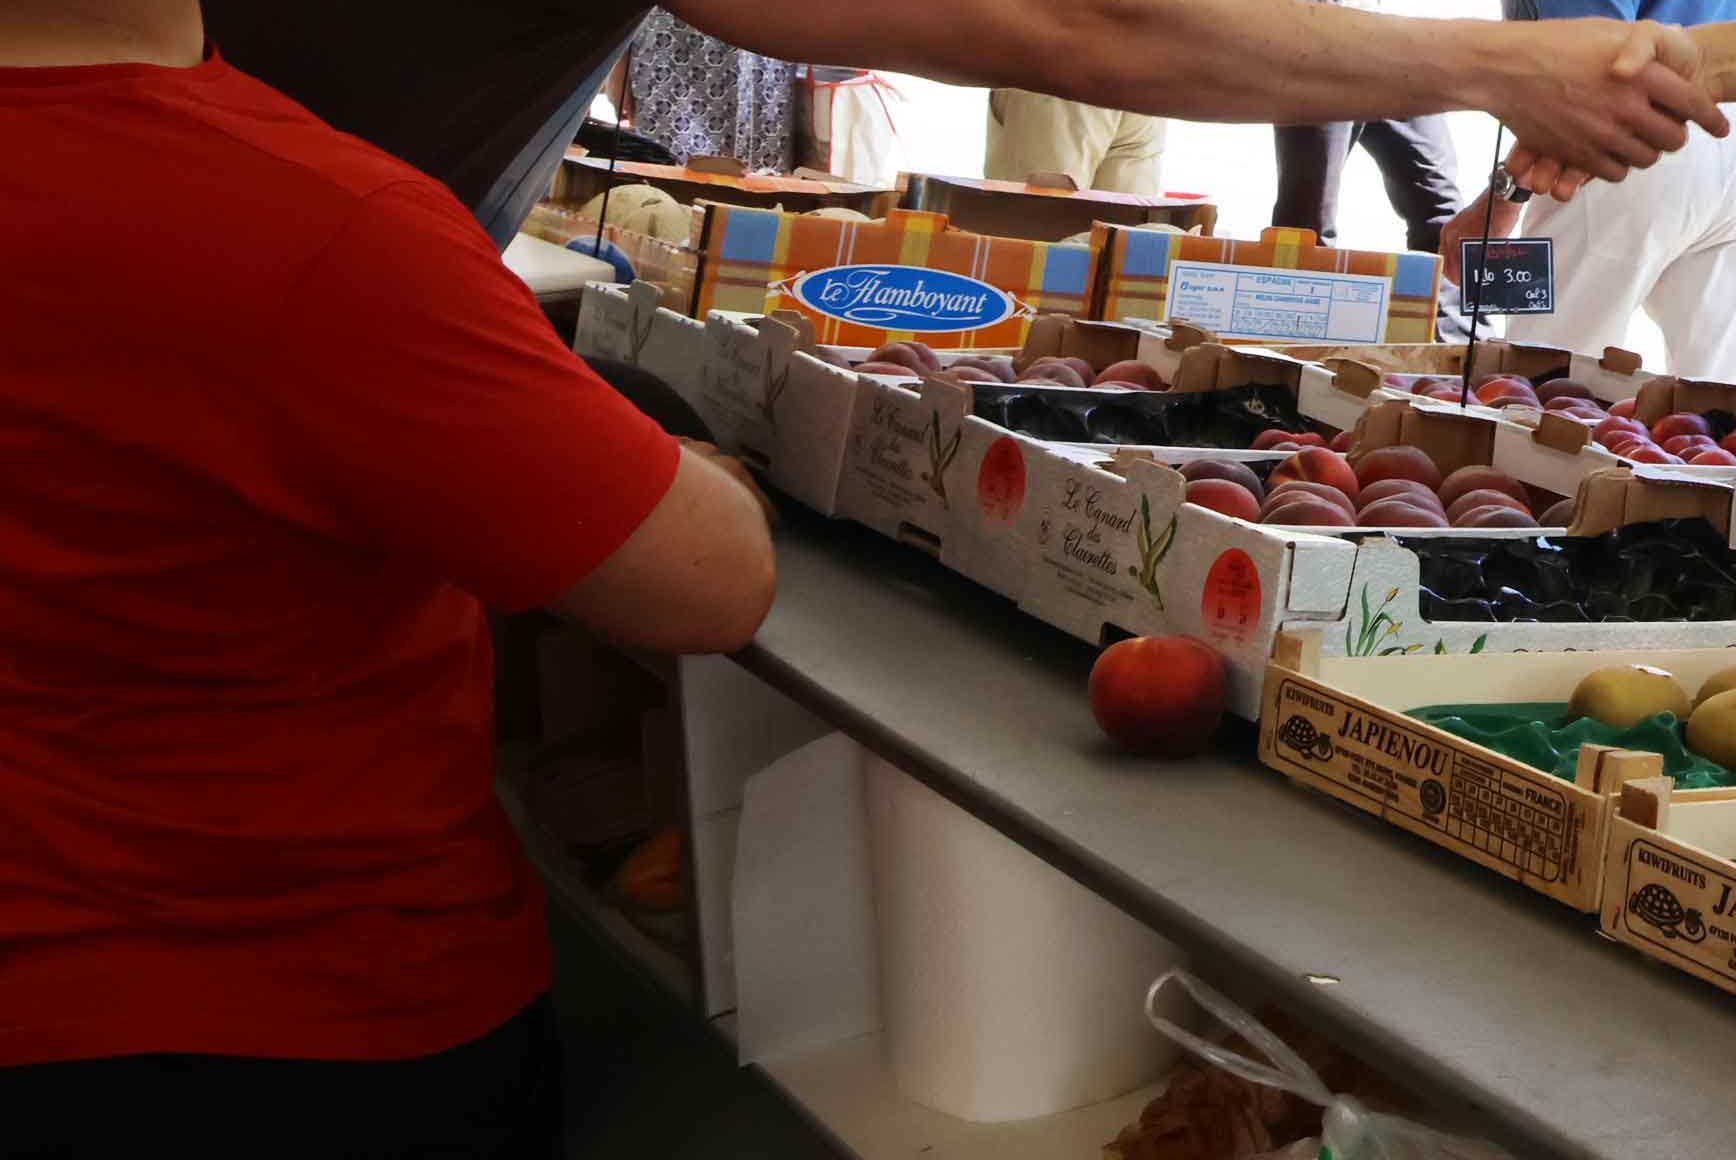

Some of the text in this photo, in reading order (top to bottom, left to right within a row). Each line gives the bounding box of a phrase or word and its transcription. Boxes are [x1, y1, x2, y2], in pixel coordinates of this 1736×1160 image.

[847, 269, 987, 315] Flamboyant
[1504, 268, 1532, 283] 3.00
[1062, 478, 1081, 512] Le
[1085, 485, 1137, 533] Canard
[1338, 711, 1448, 776] JAPIENOU
[1638, 848, 1706, 889] KIWIFRUITS
